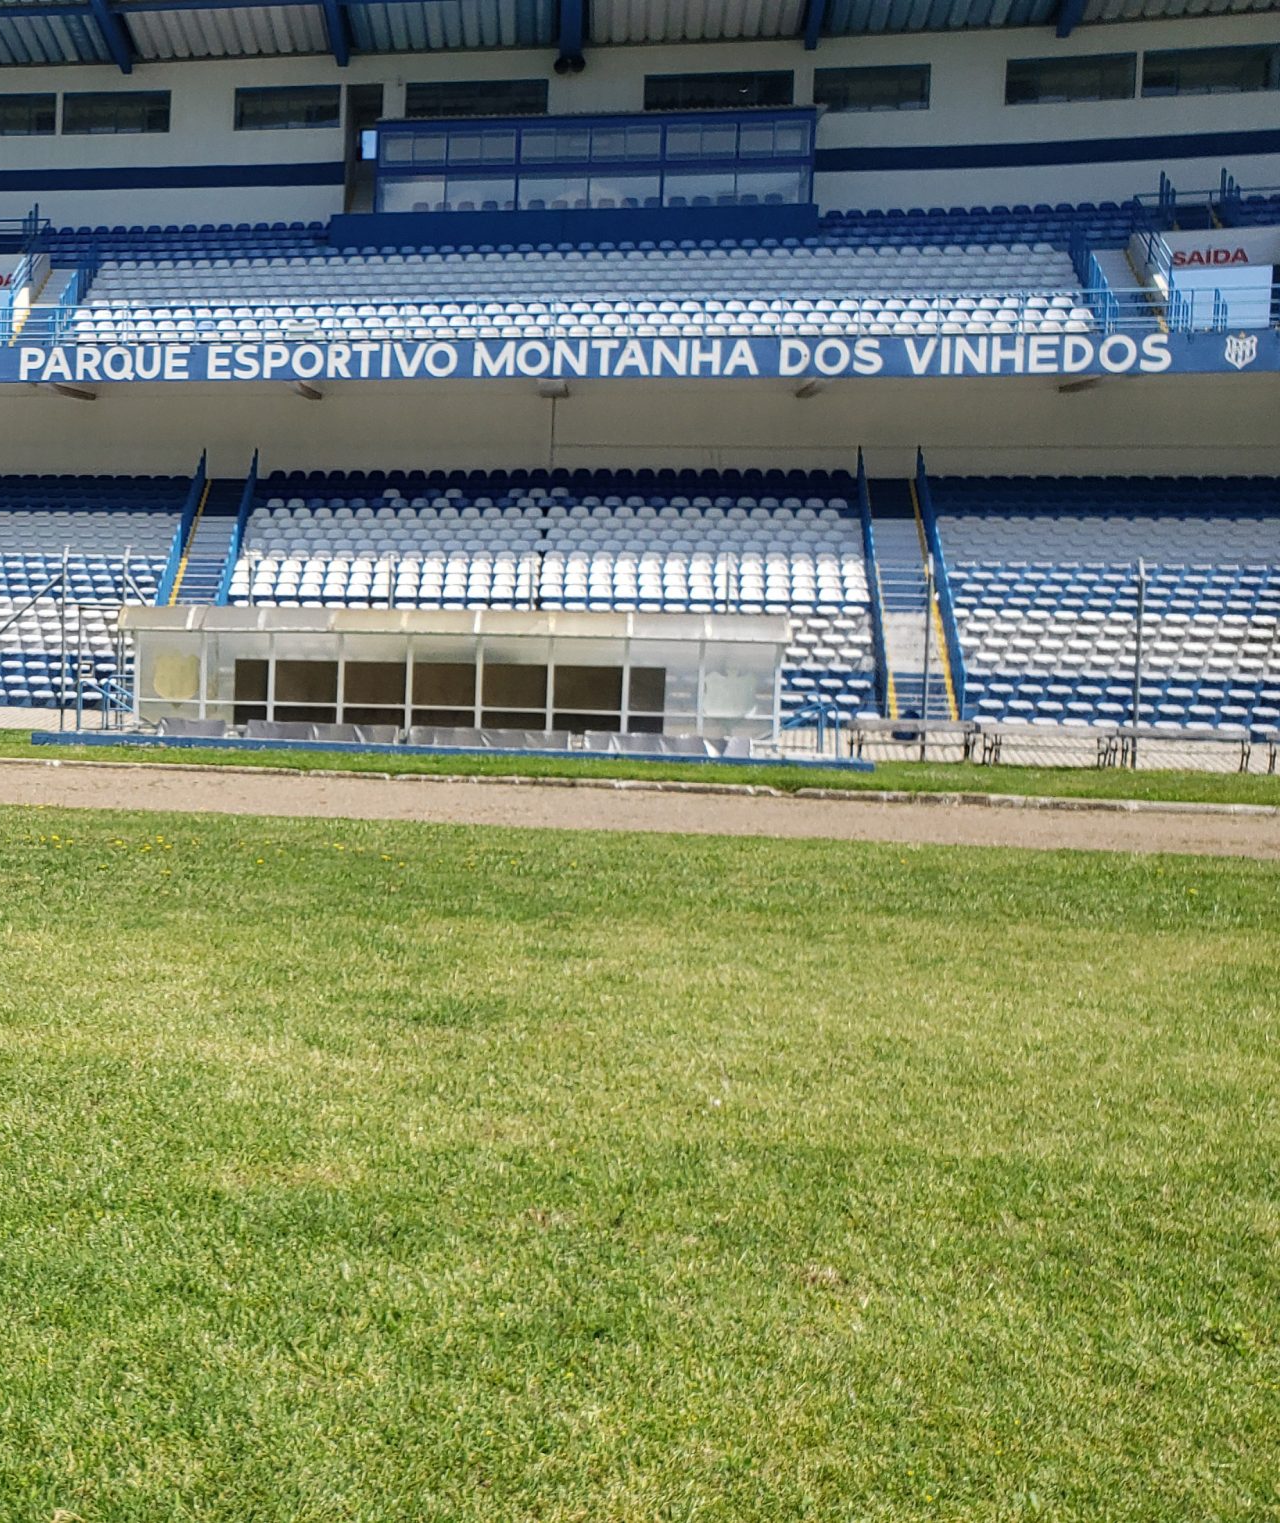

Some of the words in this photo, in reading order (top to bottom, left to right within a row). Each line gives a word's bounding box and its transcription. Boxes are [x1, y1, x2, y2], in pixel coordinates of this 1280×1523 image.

[20, 345, 189, 381] PARQUE
[207, 343, 458, 379] ESPORTIVO
[473, 339, 759, 377] MONTANHA
[779, 338, 883, 376] DOS
[904, 333, 1172, 375] VINHEDOS
